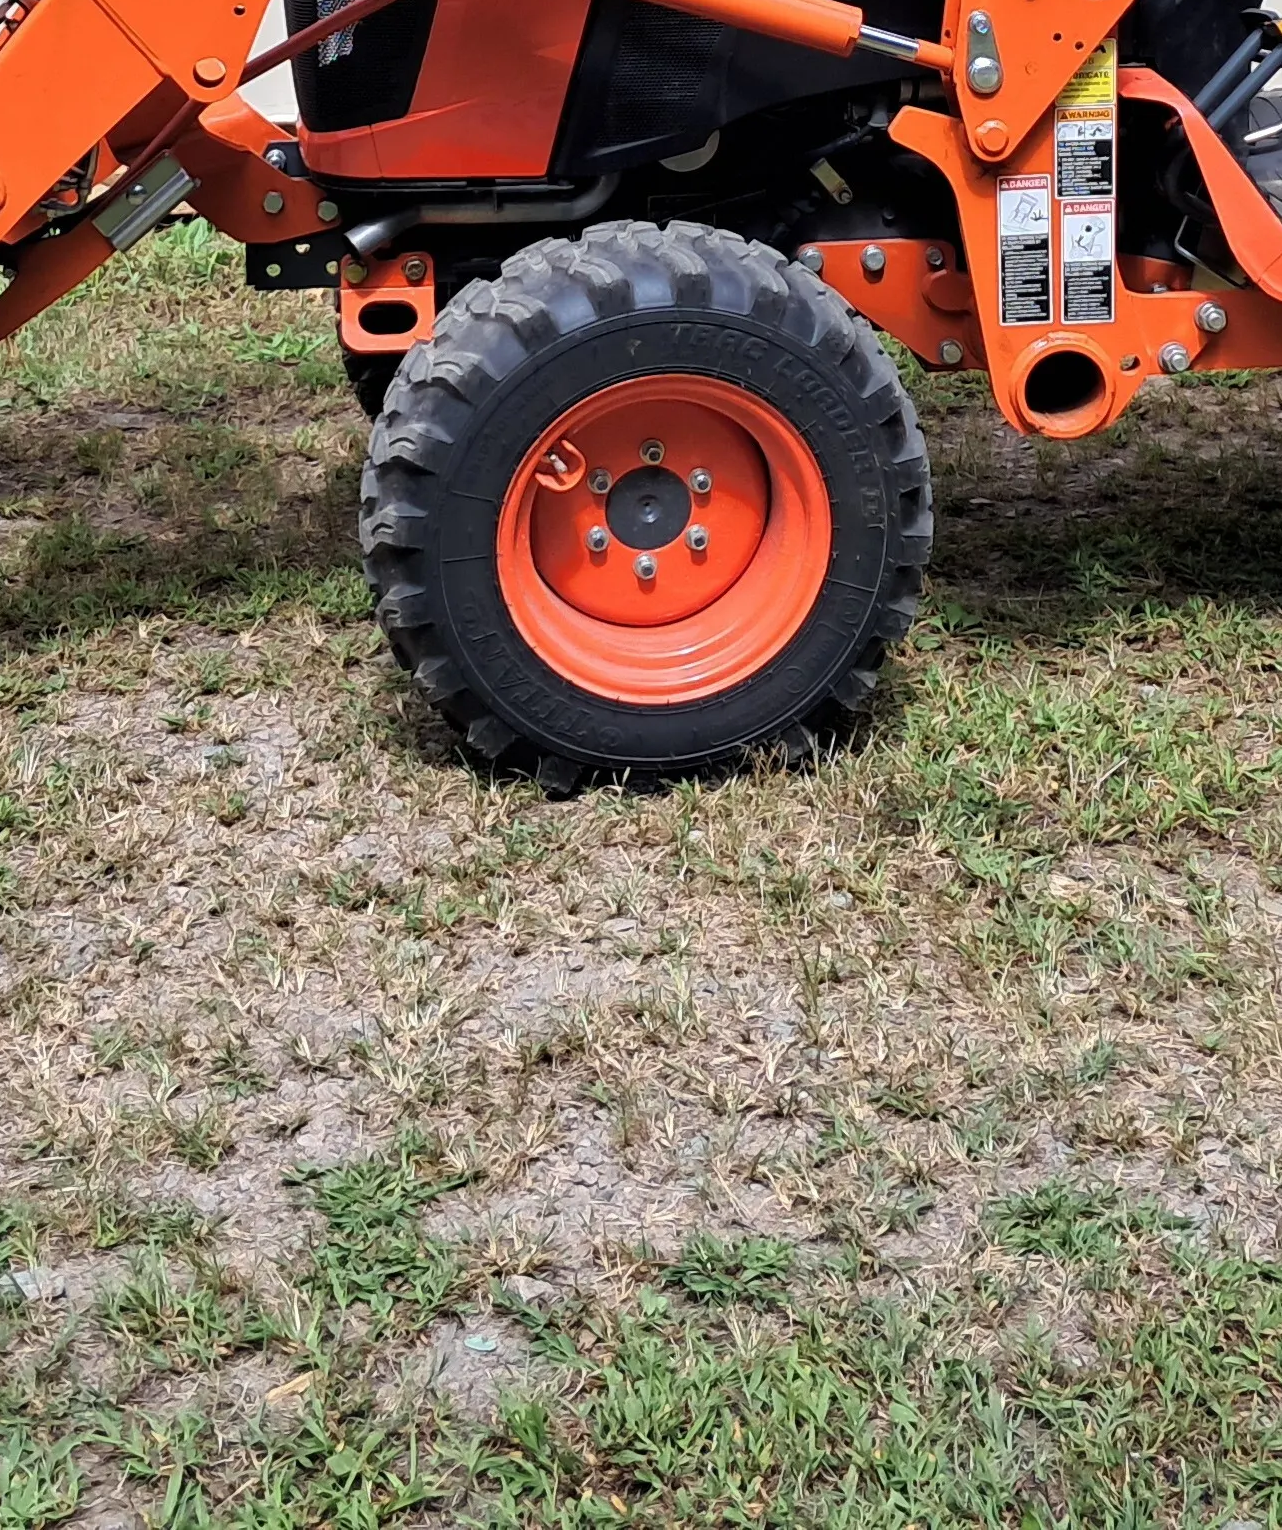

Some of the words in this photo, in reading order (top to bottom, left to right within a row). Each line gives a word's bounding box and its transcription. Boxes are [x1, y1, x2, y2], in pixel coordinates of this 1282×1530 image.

[1009, 179, 1048, 189] DANGER
[1074, 203, 1111, 213] DANGER
[471, 629, 594, 741] TITAN
